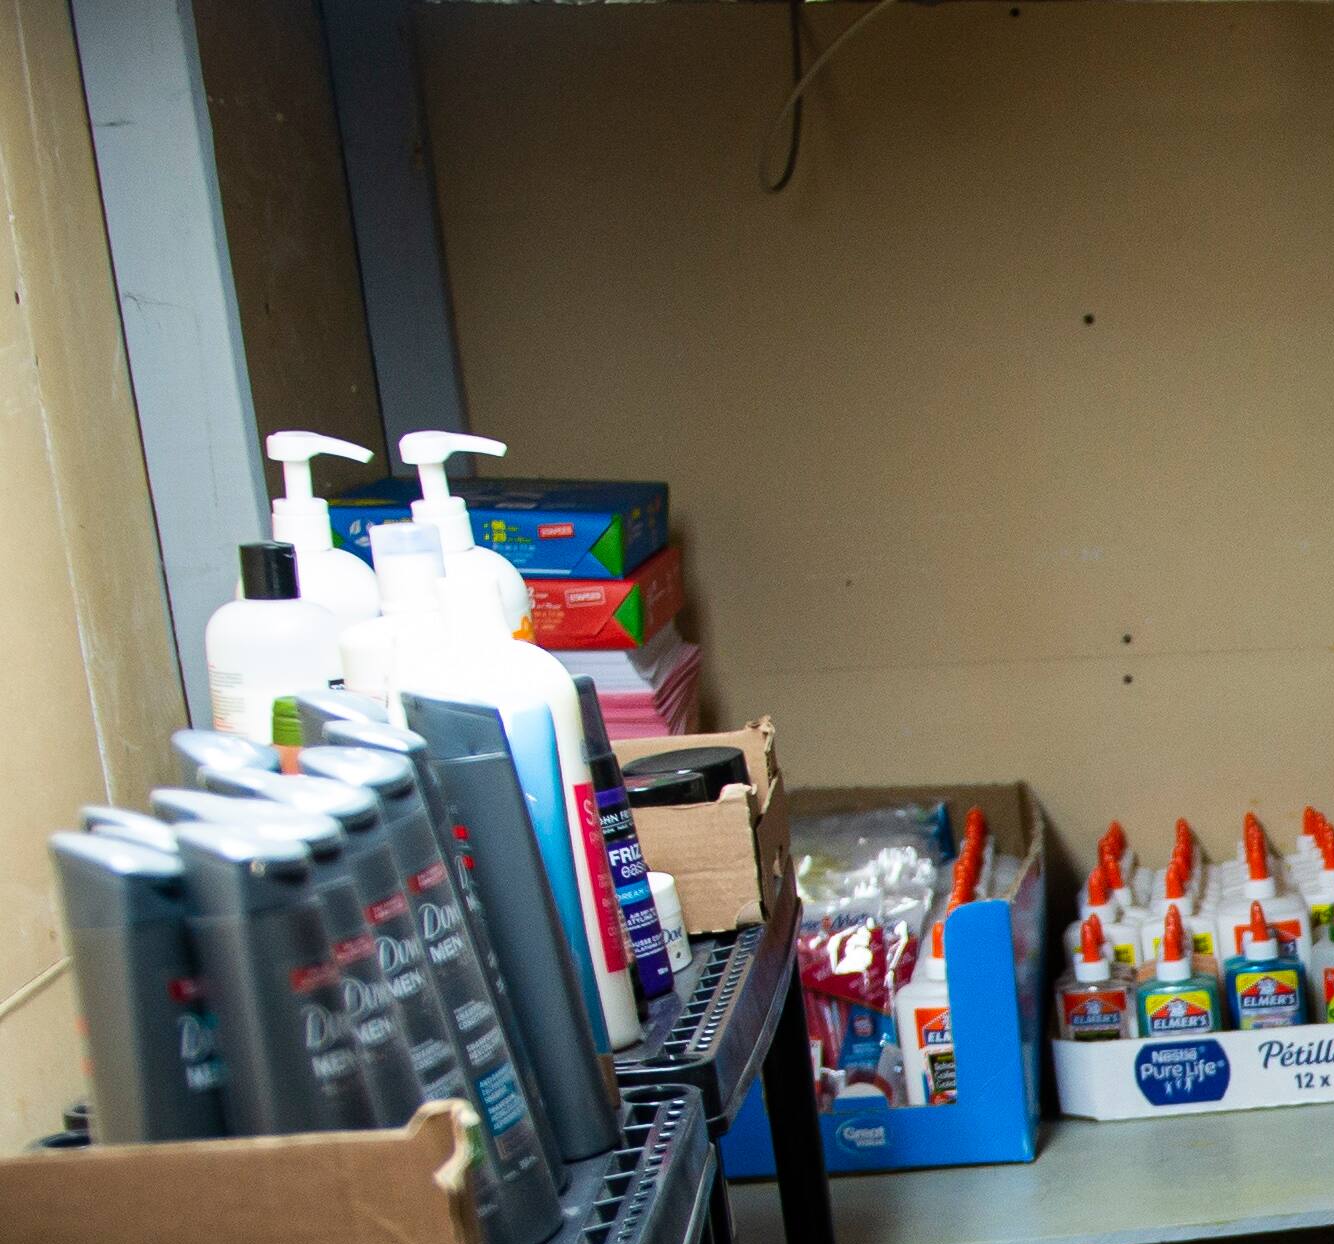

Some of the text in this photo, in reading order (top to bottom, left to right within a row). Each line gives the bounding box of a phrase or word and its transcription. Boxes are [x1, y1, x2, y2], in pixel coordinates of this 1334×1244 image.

[1242, 994, 1296, 1007] ELMER'S
[1073, 1013, 1119, 1025] ELMER'S
[1153, 1016, 1209, 1030] ELMER'S
[1140, 1058, 1217, 1082] Pure Life
[1294, 1071, 1315, 1090] 12
[1319, 1074, 1331, 1088] x
